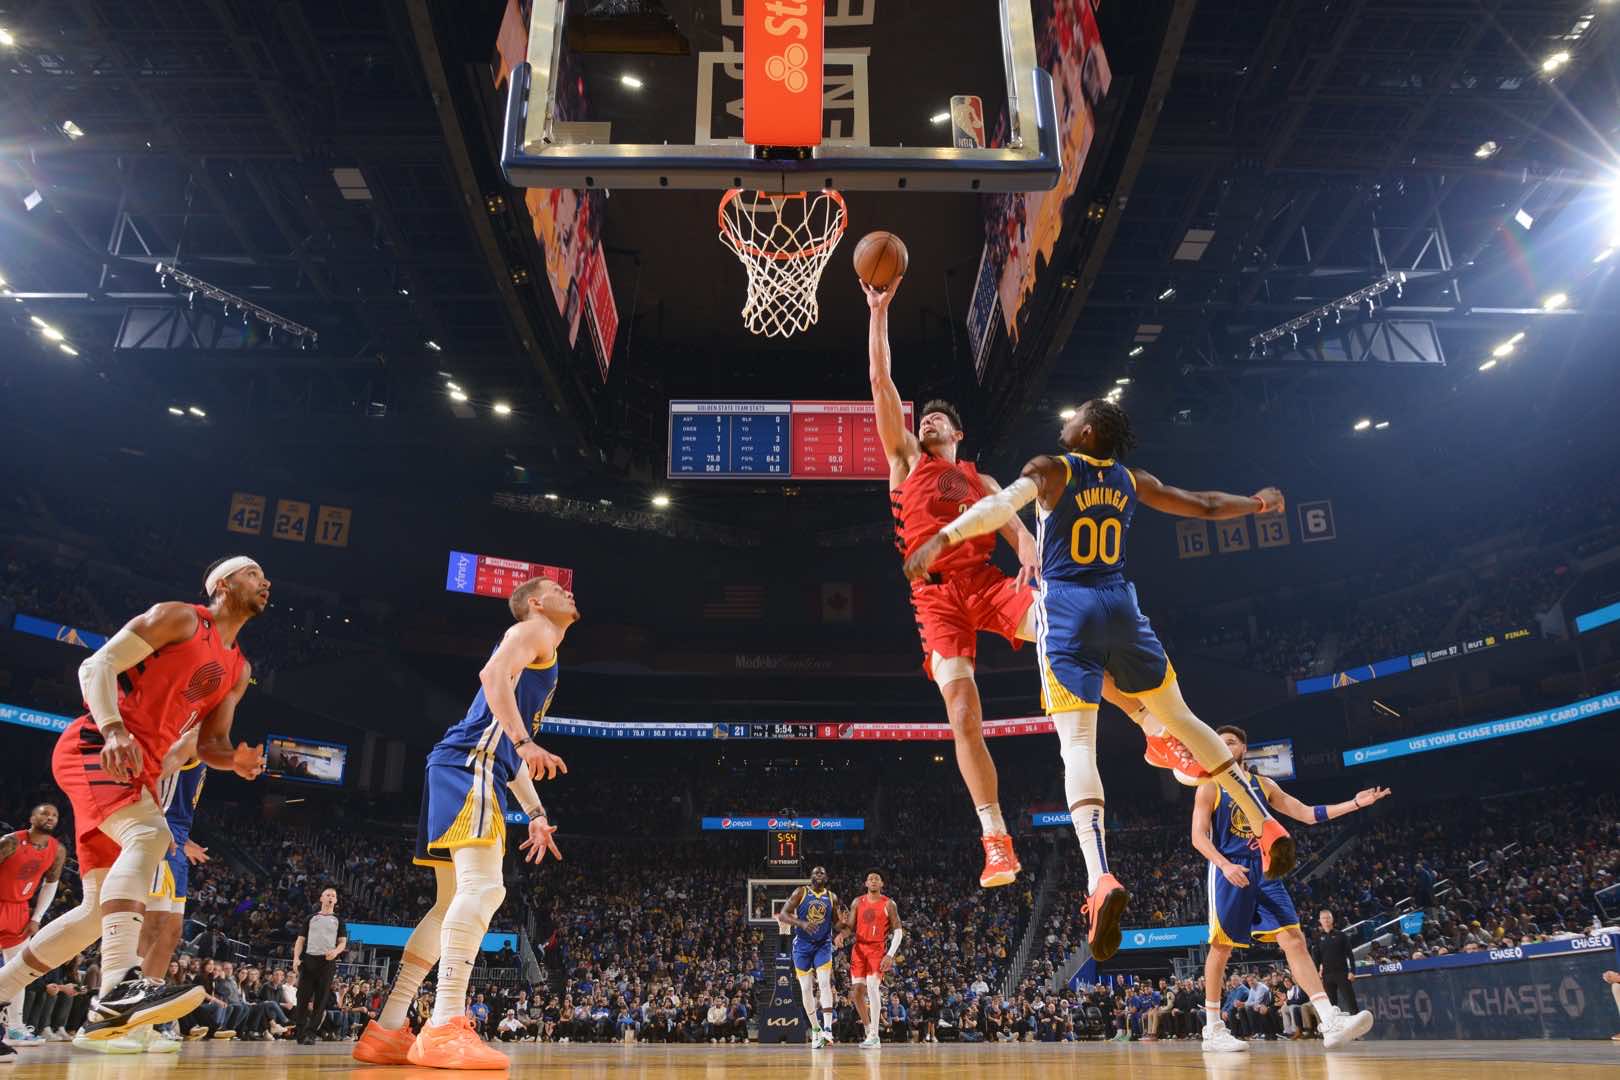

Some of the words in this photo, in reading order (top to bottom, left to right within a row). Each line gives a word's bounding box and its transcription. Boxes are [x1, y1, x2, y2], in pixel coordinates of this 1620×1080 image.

[1075, 487, 1129, 512] KUMINGA
[1306, 509, 1327, 533] 6
[321, 520, 344, 541] 17
[1261, 522, 1284, 543] 13
[1071, 516, 1122, 565] 00
[1223, 527, 1243, 548] 14
[455, 554, 470, 589] xfinity
[1504, 628, 1530, 640] FINAL
[19, 712, 51, 726] CARD
[1409, 738, 1427, 750] USE
[1429, 734, 1458, 746] YOUR
[1457, 726, 1491, 741] CHASE
[1550, 707, 1579, 722] CARD
[1580, 701, 1601, 715] FOR
[617, 729, 624, 737] 10
[734, 725, 745, 737] 21
[775, 723, 793, 734] 5:54
[824, 726, 831, 737] 9
[732, 820, 752, 829] pepsi
[821, 820, 842, 829] pepsi
[1042, 814, 1071, 824] CHASE
[777, 833, 797, 842] 5:54
[779, 841, 795, 857] 17
[1149, 932, 1178, 942] freedom
[1571, 937, 1602, 951] CHASE
[1489, 948, 1516, 961] CHASE
[1378, 963, 1398, 974] CHASE
[1468, 983, 1556, 1017] CHASE
